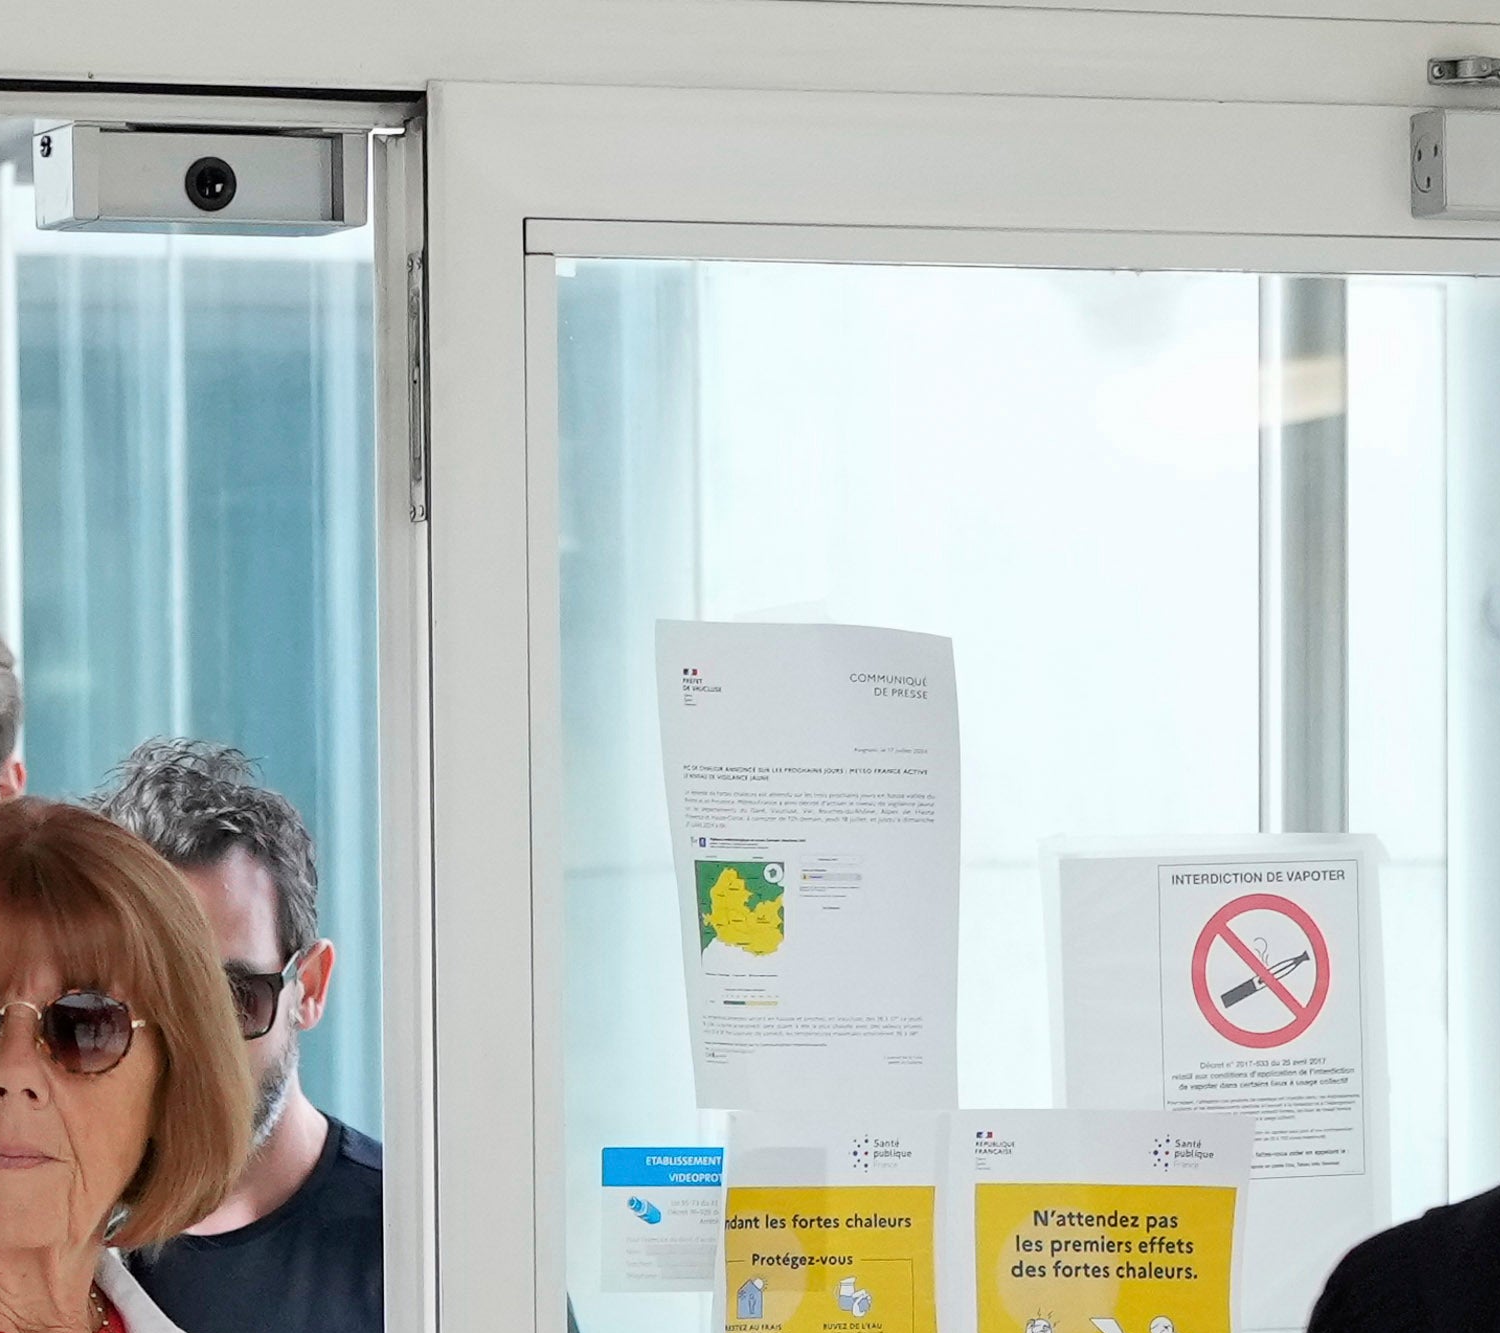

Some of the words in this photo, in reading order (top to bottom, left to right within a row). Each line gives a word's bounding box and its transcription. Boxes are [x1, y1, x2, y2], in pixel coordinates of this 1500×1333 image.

[874, 687, 889, 697] DE
[891, 688, 928, 700] PRESSE
[1172, 872, 1263, 885] INTERDICTION
[1266, 871, 1284, 882] DE
[1286, 870, 1345, 881] VAPOTER
[873, 1138, 900, 1148] Santé
[1175, 1138, 1201, 1149] Santé
[645, 1156, 721, 1166] ETABLISSEMENT
[873, 1149, 913, 1160] publique
[1174, 1149, 1214, 1160] publique
[765, 1215, 786, 1229] les
[792, 1214, 839, 1229] fortes
[845, 1213, 911, 1229] chaleurs
[1033, 1210, 1140, 1228] N'attendez
[1146, 1214, 1178, 1232] pas
[1016, 1235, 1043, 1253] les
[1051, 1235, 1132, 1257] premiers
[1138, 1236, 1194, 1254] effets
[752, 1253, 853, 1269] Protégez-vous
[1011, 1261, 1046, 1278] des
[1053, 1260, 1110, 1278] fortes
[1116, 1262, 1198, 1279] chaleurs.
